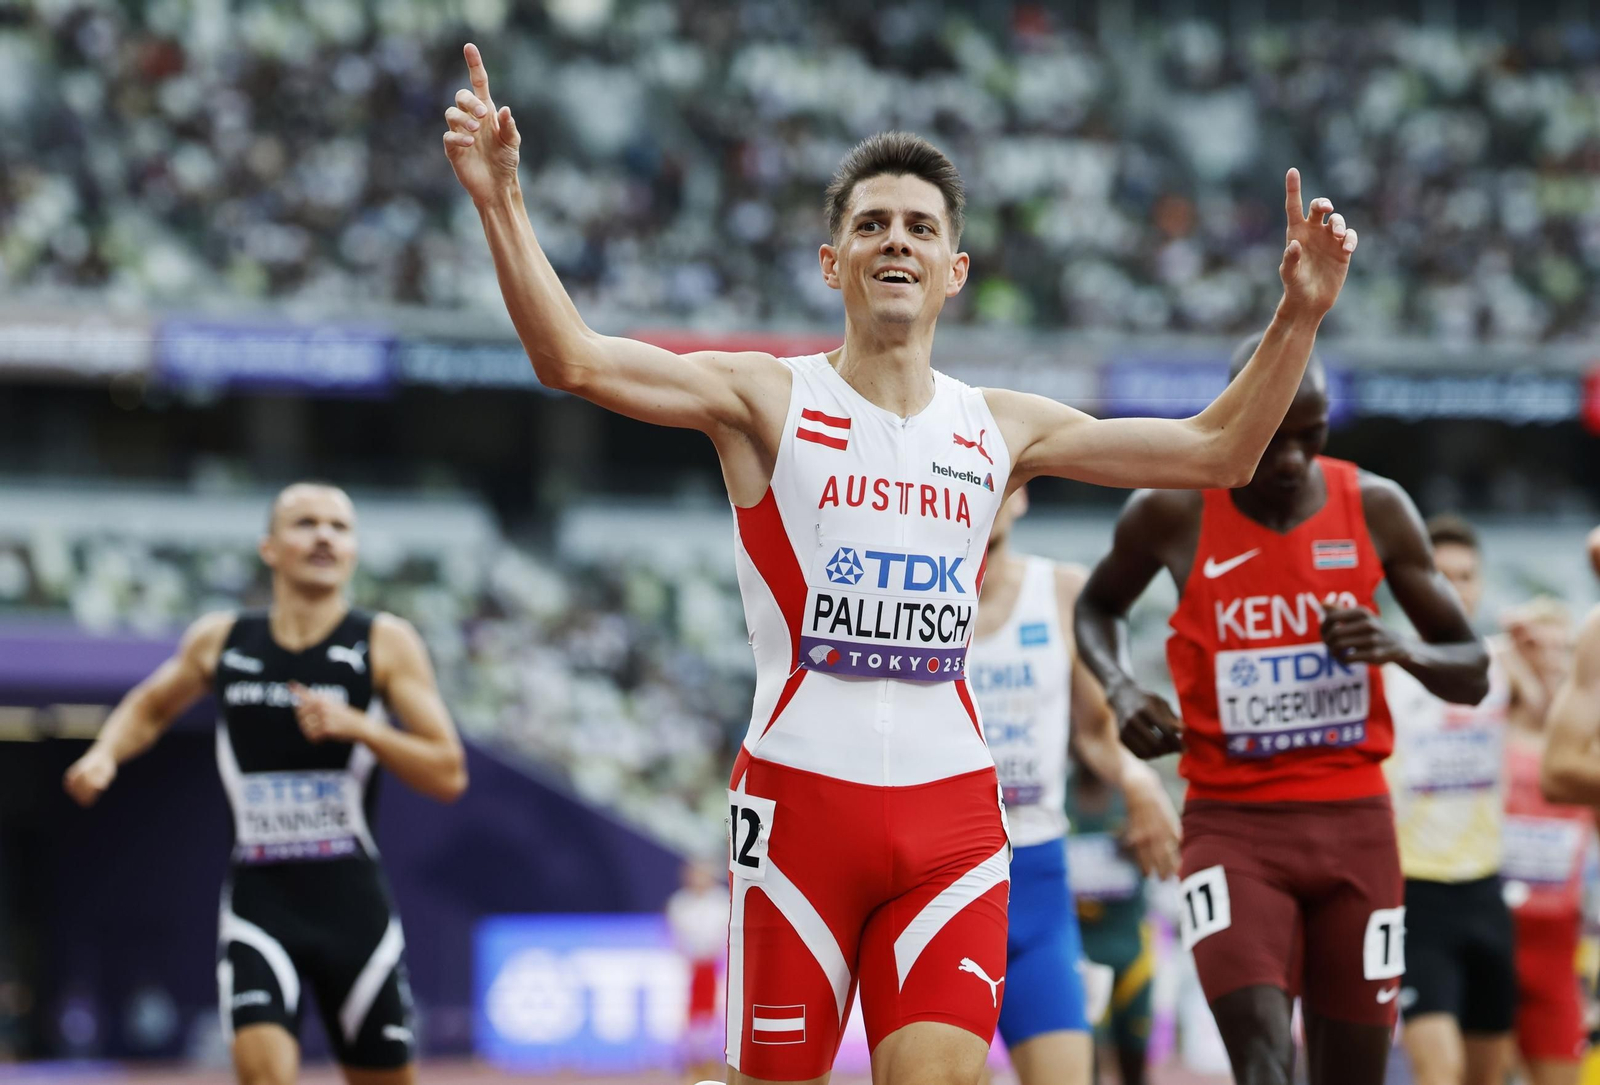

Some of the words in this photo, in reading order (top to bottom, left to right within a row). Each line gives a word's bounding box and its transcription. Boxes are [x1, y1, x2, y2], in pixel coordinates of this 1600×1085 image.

[932, 462, 981, 485] helvetia
[818, 475, 971, 528] AUSTRIA
[865, 551, 966, 593] TDK
[812, 593, 972, 643] PALLITSCH
[849, 651, 940, 673] TOKYO
[1248, 682, 1363, 726] CHERUIYOT
[730, 804, 761, 868] 12
[1186, 883, 1214, 930] 11
